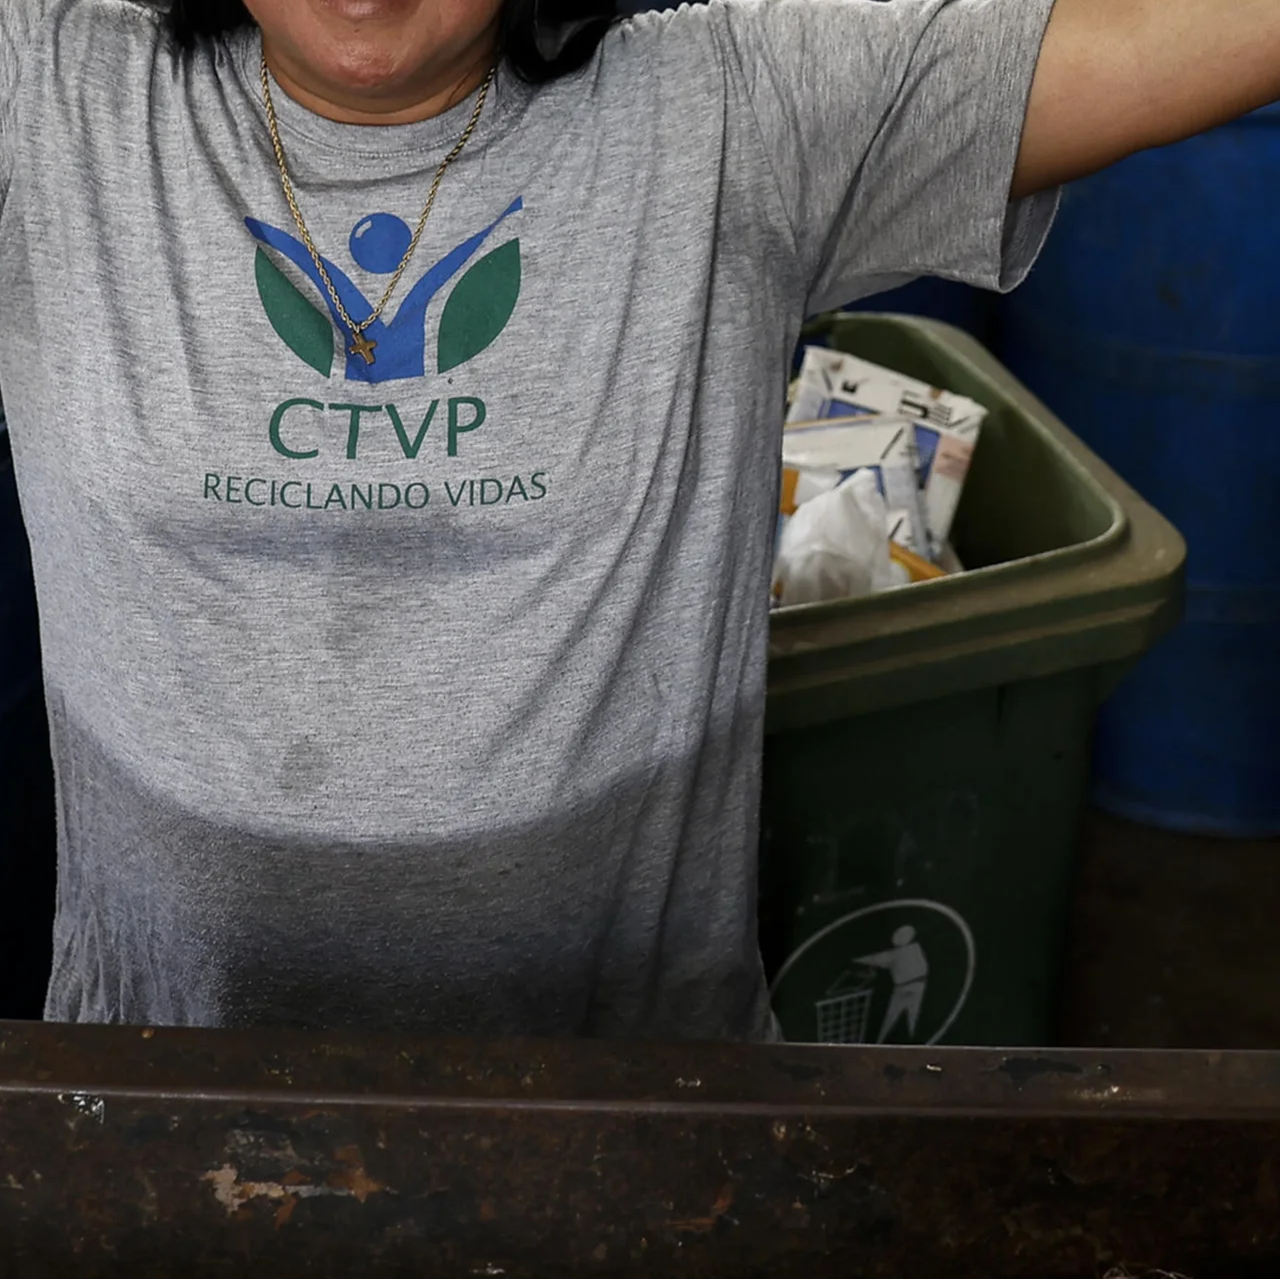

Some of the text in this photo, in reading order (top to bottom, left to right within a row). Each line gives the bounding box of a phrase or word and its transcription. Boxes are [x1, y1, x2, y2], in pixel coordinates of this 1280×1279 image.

[269, 396, 486, 460] CTVP
[203, 472, 547, 510] RECICLANDO VIDAS
